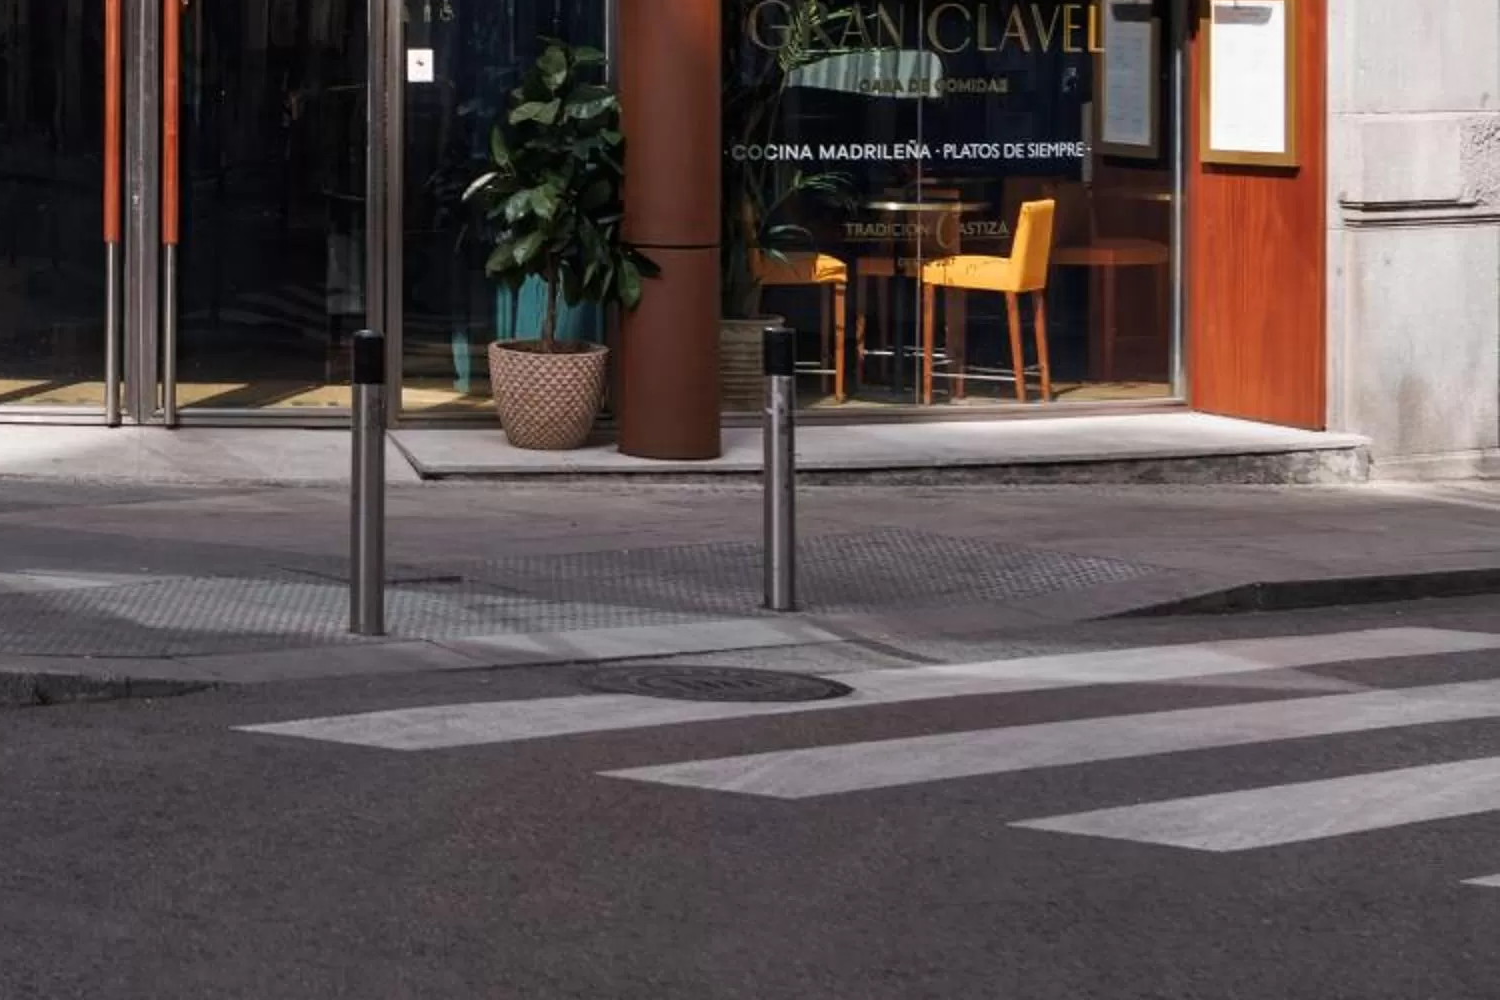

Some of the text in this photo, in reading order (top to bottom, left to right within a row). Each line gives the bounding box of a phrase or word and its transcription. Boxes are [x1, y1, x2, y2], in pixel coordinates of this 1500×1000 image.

[927, 3, 1106, 54] CLAVEL
[731, 139, 1085, 161] COCINA MADRILEÑA PLATOS DE SIEMPRE
